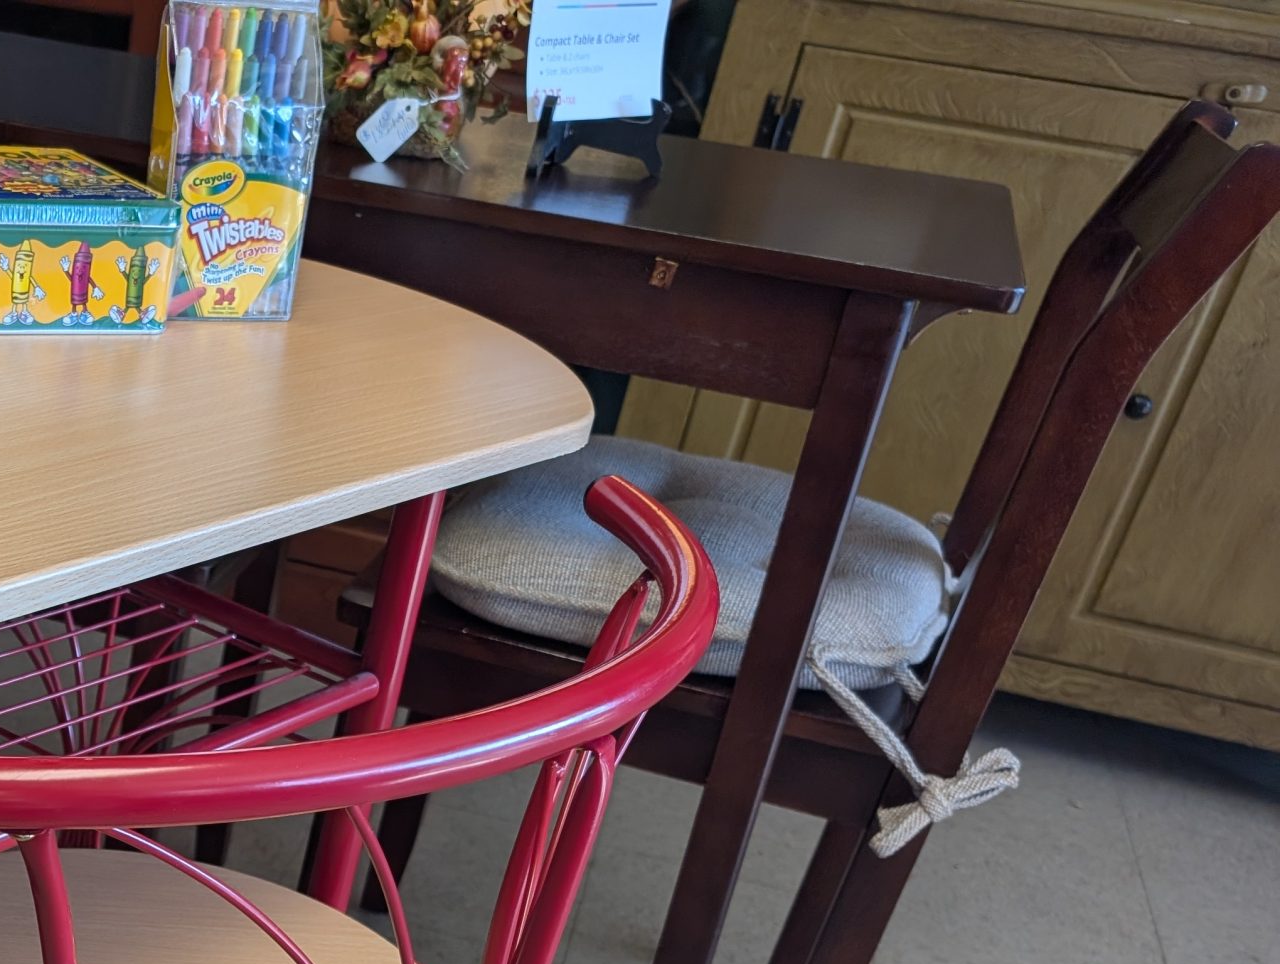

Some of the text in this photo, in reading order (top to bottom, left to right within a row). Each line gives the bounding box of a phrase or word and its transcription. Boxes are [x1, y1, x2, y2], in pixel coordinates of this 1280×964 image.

[535, 36, 571, 49] Compact
[573, 34, 595, 46] Table
[604, 32, 625, 45] Chair
[626, 32, 640, 44] Set
[192, 172, 232, 187] Crayola
[192, 203, 223, 219] mini
[189, 215, 285, 263] Twistables
[235, 244, 279, 261] Crayons
[202, 273, 222, 284] Twist
[223, 274, 233, 283] up
[249, 265, 264, 276] Fun!
[214, 287, 236, 306] 24
